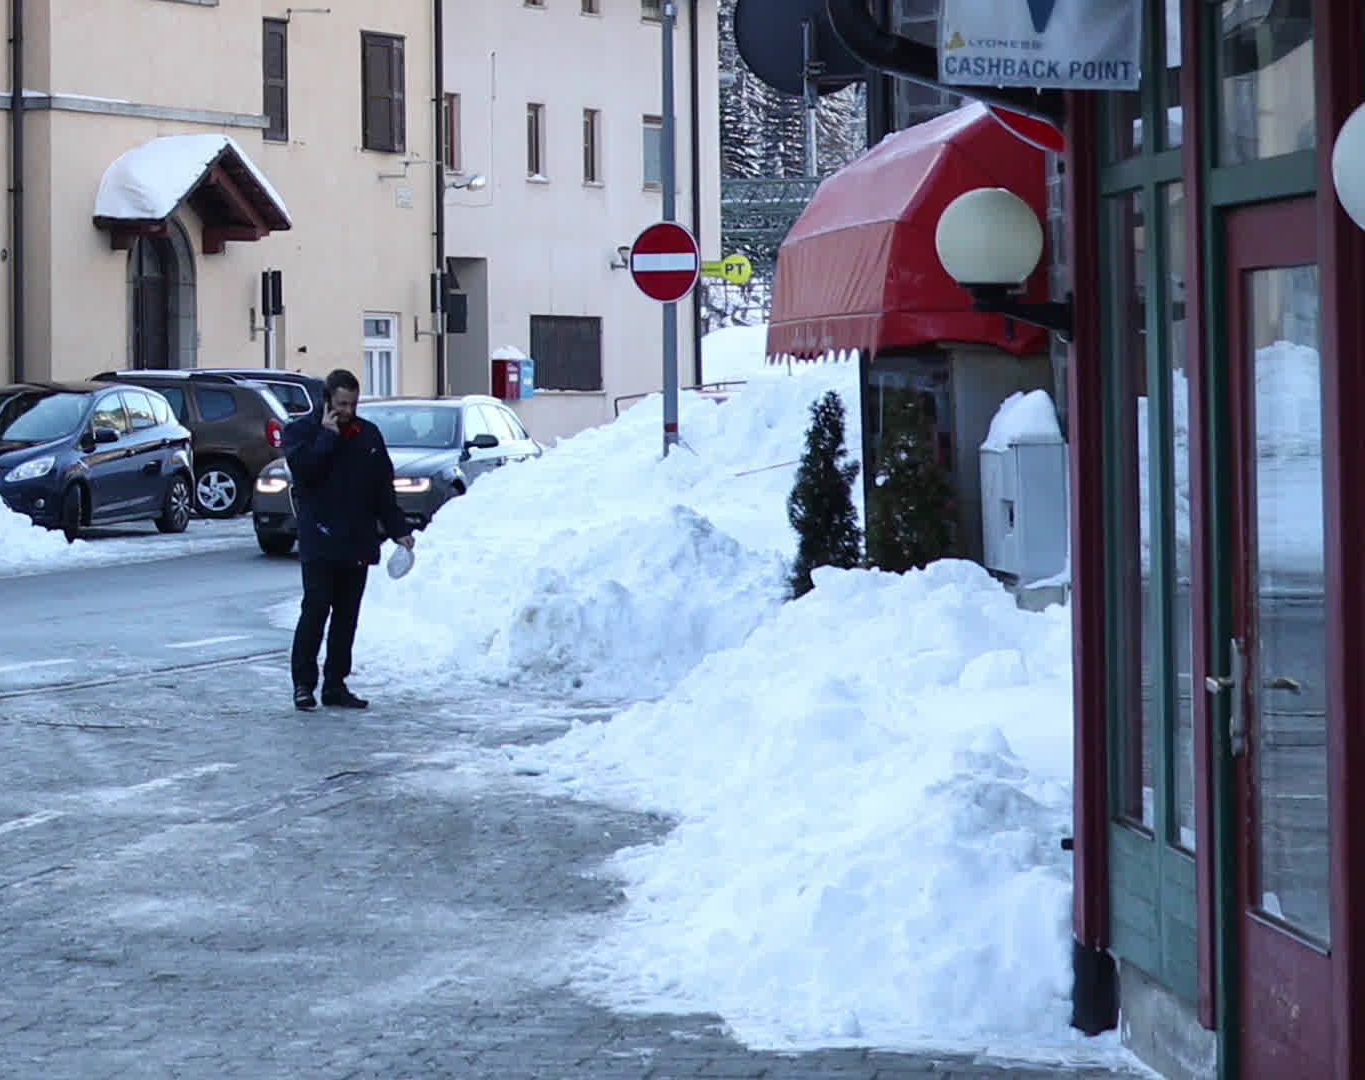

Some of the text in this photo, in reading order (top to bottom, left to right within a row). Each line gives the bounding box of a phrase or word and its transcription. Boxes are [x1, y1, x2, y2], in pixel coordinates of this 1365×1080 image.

[944, 56, 1134, 81] CASHBACK POINT
[725, 263, 745, 276] PT
